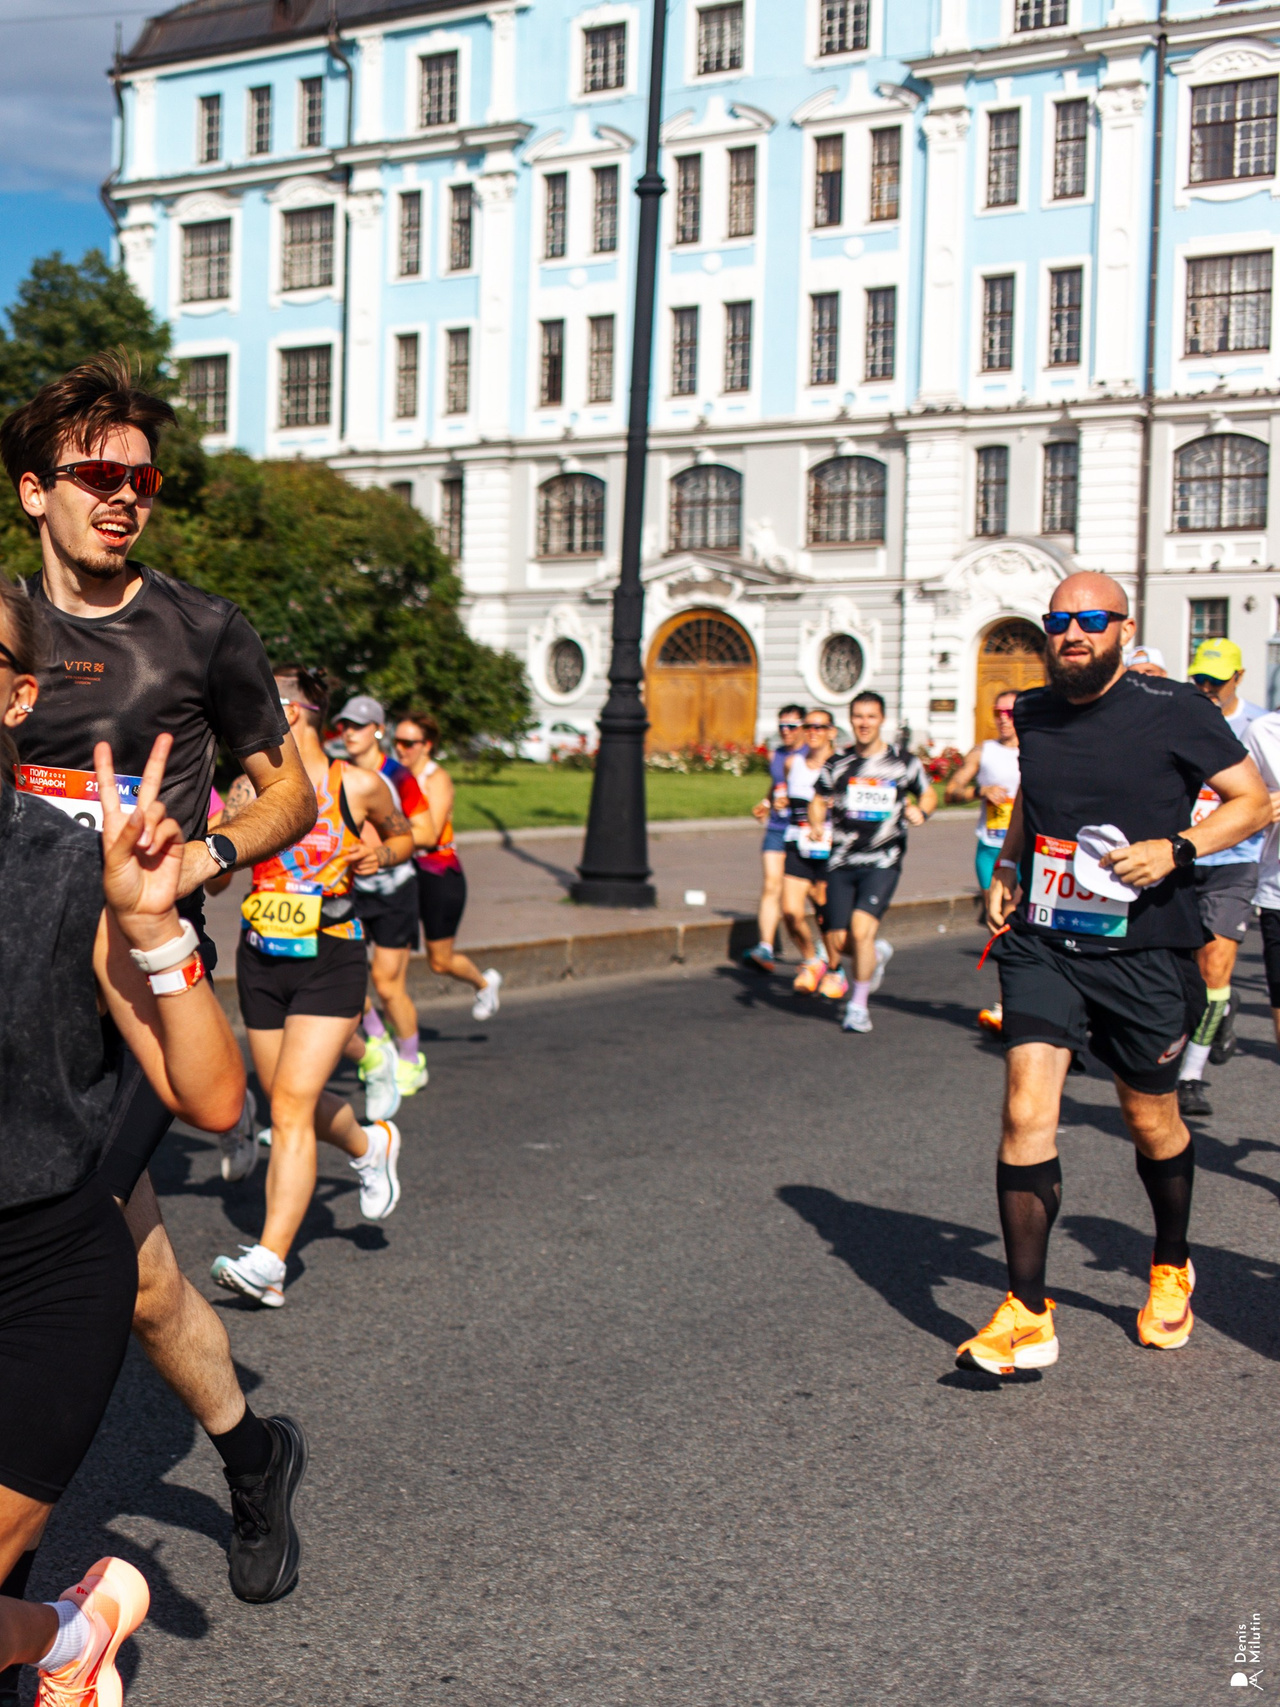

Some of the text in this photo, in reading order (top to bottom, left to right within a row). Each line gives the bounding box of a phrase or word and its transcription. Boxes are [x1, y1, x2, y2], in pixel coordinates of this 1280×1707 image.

[64, 660, 92, 672] VTR
[29, 768, 48, 778] ПОЛУ
[29, 776, 66, 788] МАРАФОН
[249, 899, 306, 924] 2406
